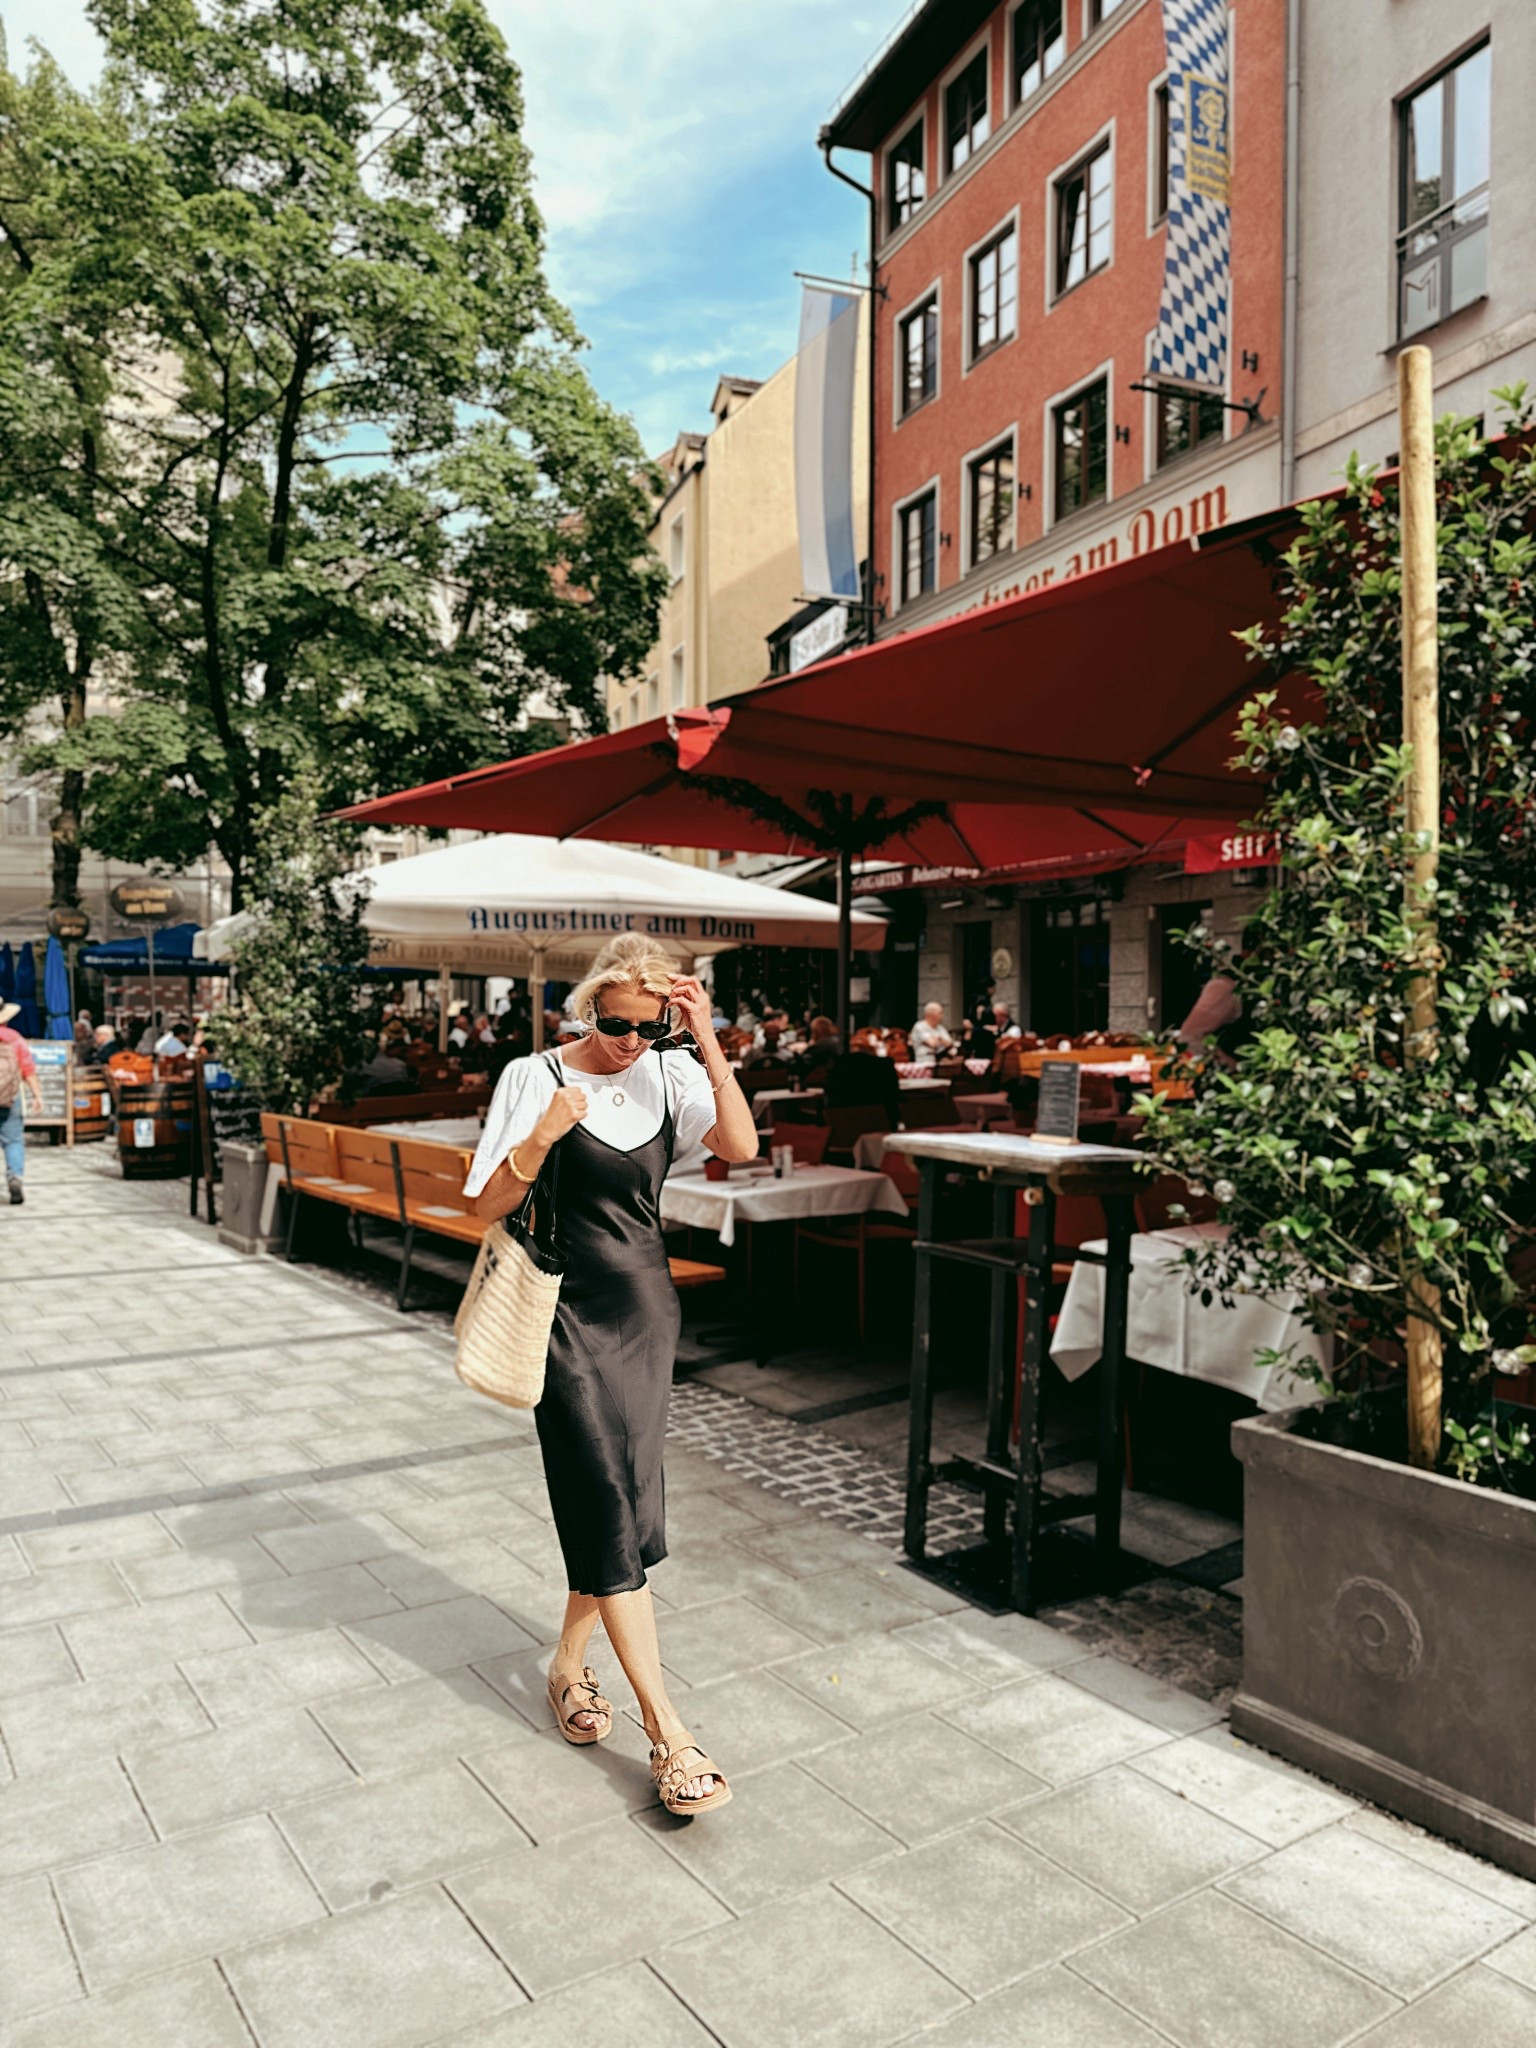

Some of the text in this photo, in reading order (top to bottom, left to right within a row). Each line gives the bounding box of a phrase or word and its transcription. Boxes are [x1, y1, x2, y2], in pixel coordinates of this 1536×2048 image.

[1128, 485, 1231, 556] Dom
[467, 906, 756, 940] Augustiner am Dom
